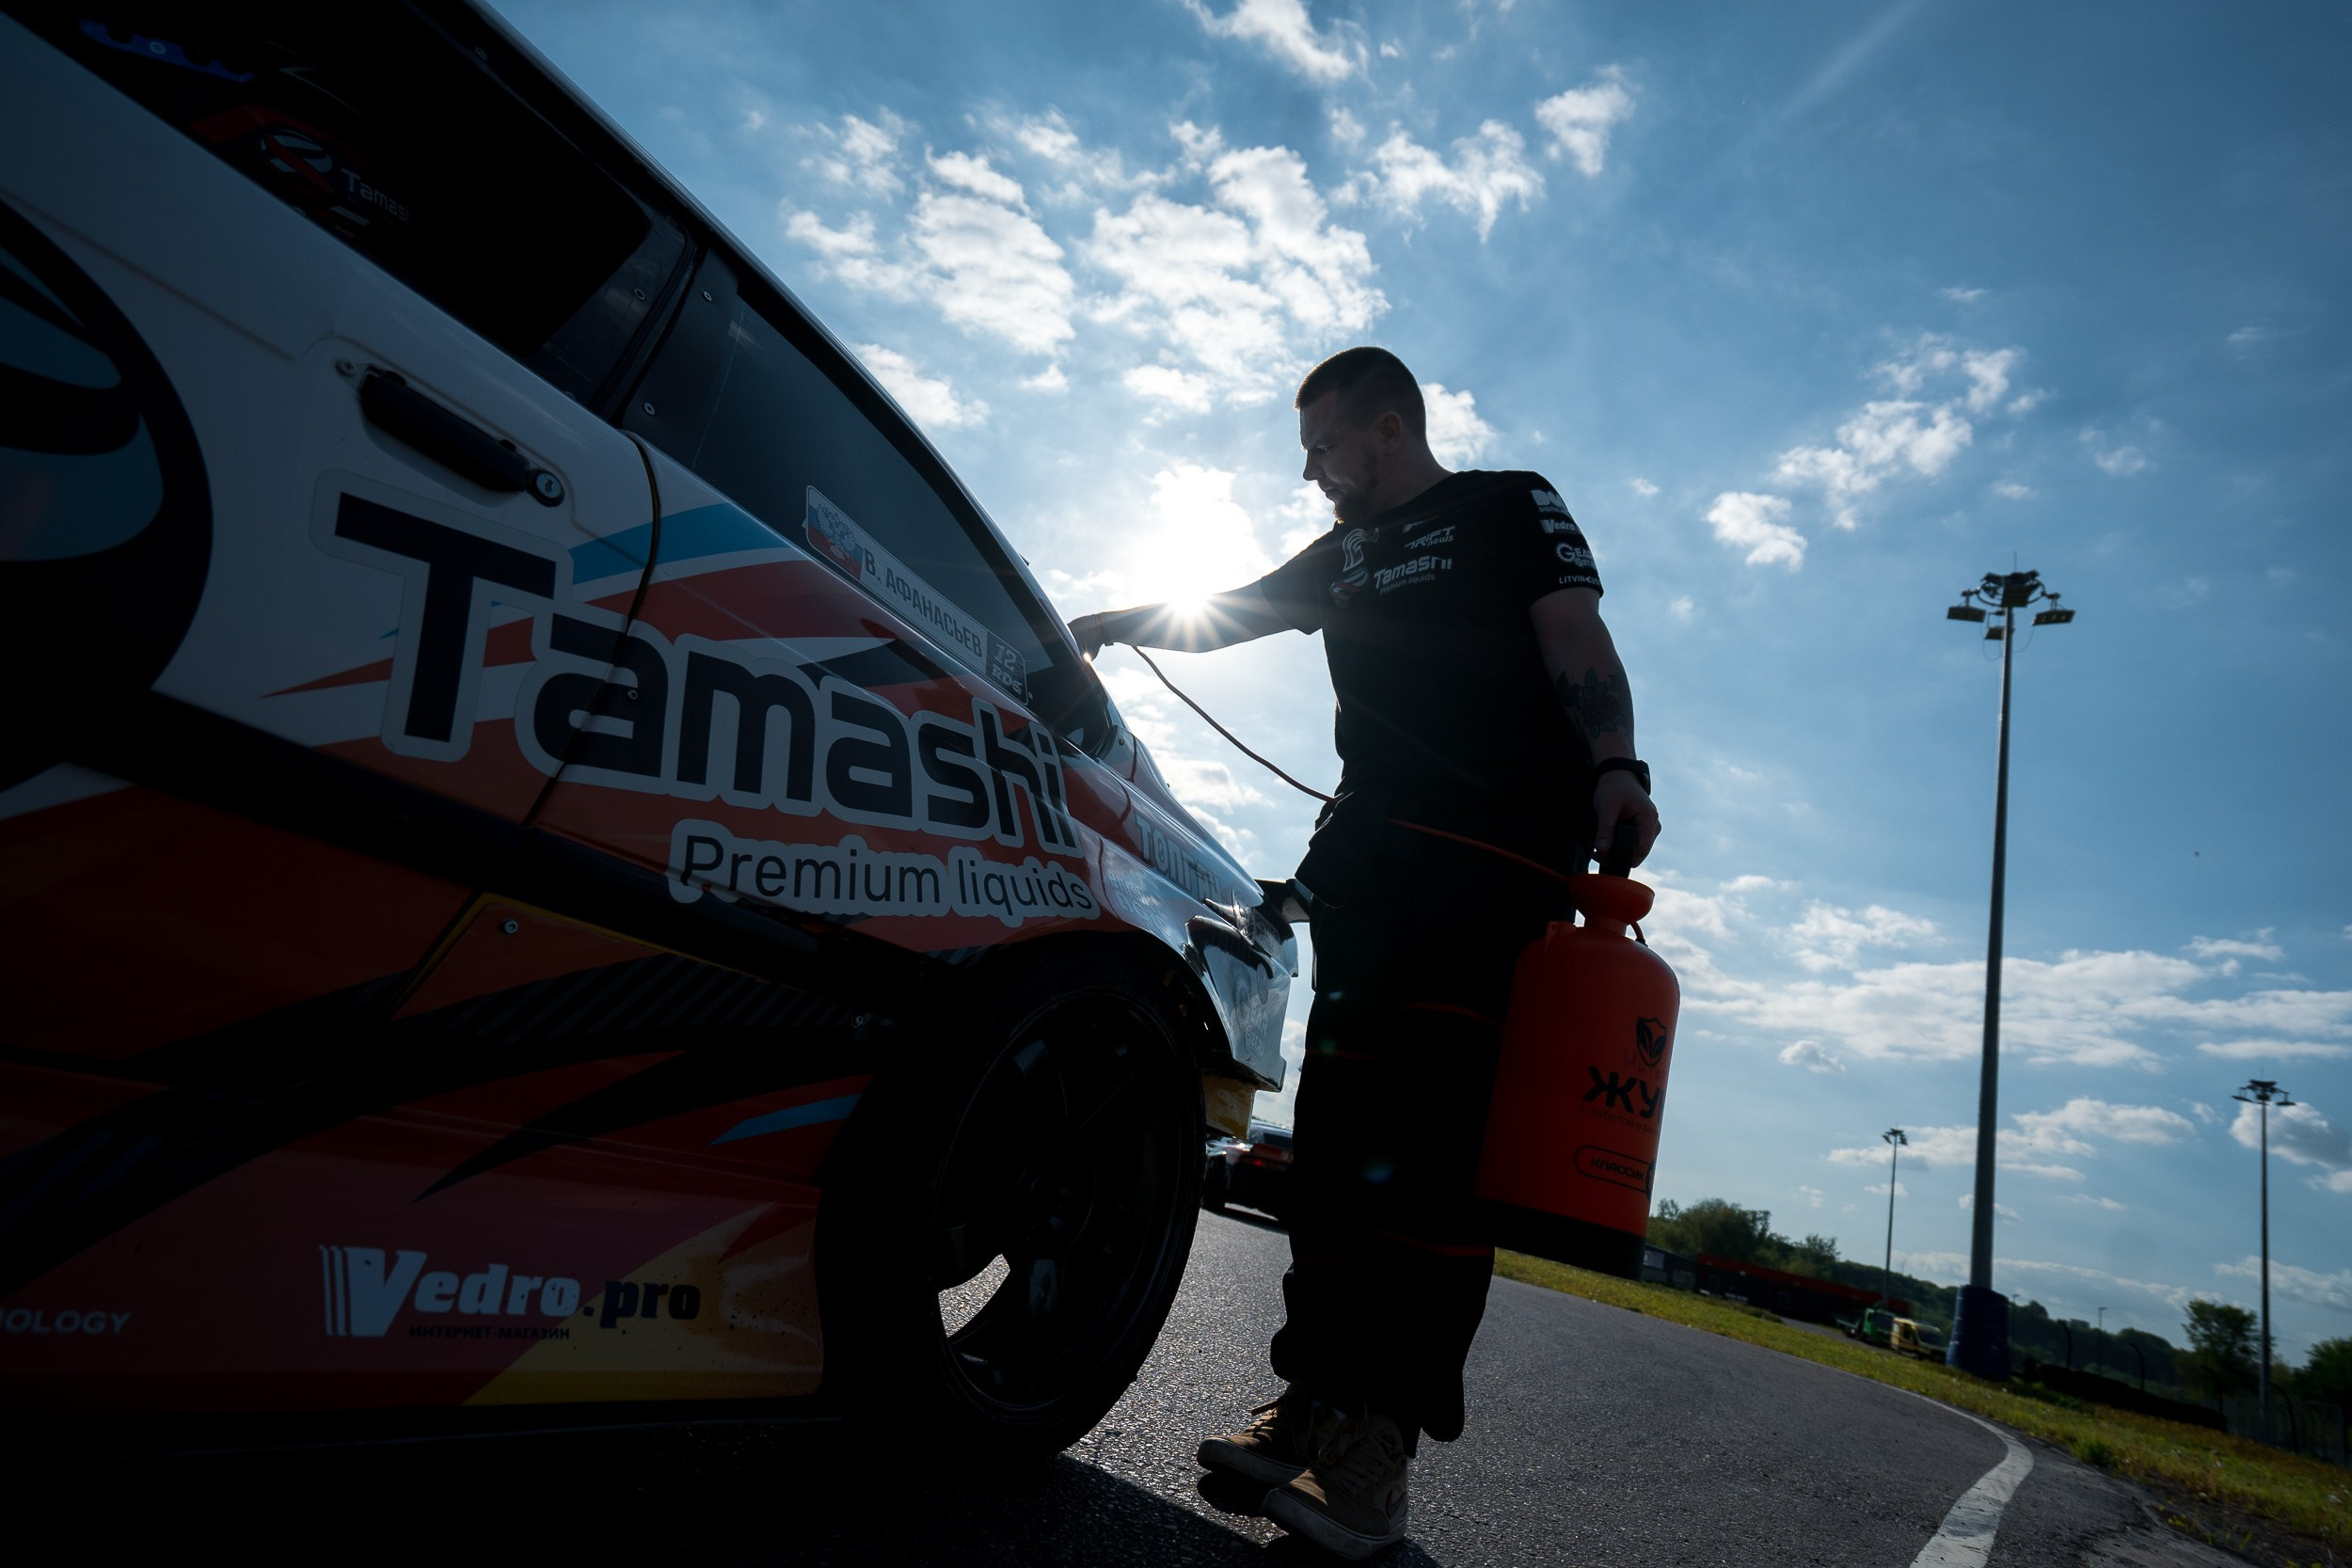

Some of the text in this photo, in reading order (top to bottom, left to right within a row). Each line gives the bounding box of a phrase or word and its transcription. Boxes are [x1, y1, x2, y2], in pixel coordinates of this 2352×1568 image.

[1408, 573, 1437, 585] liquids
[865, 548, 982, 658] В. АФАНАСЬЕВ
[335, 492, 1077, 848] Tamashi
[992, 663, 1024, 698] RDS
[994, 643, 1017, 672] 12
[681, 834, 940, 903] Premium
[958, 858, 1092, 915] liquids
[1581, 1065, 1664, 1124] ЖУ
[319, 1243, 701, 1338] Vedro.pro
[0, 1307, 132, 1337] OLOGY
[408, 1323, 571, 1341] ИНТЕРНЕТ-МАГАЗИН
